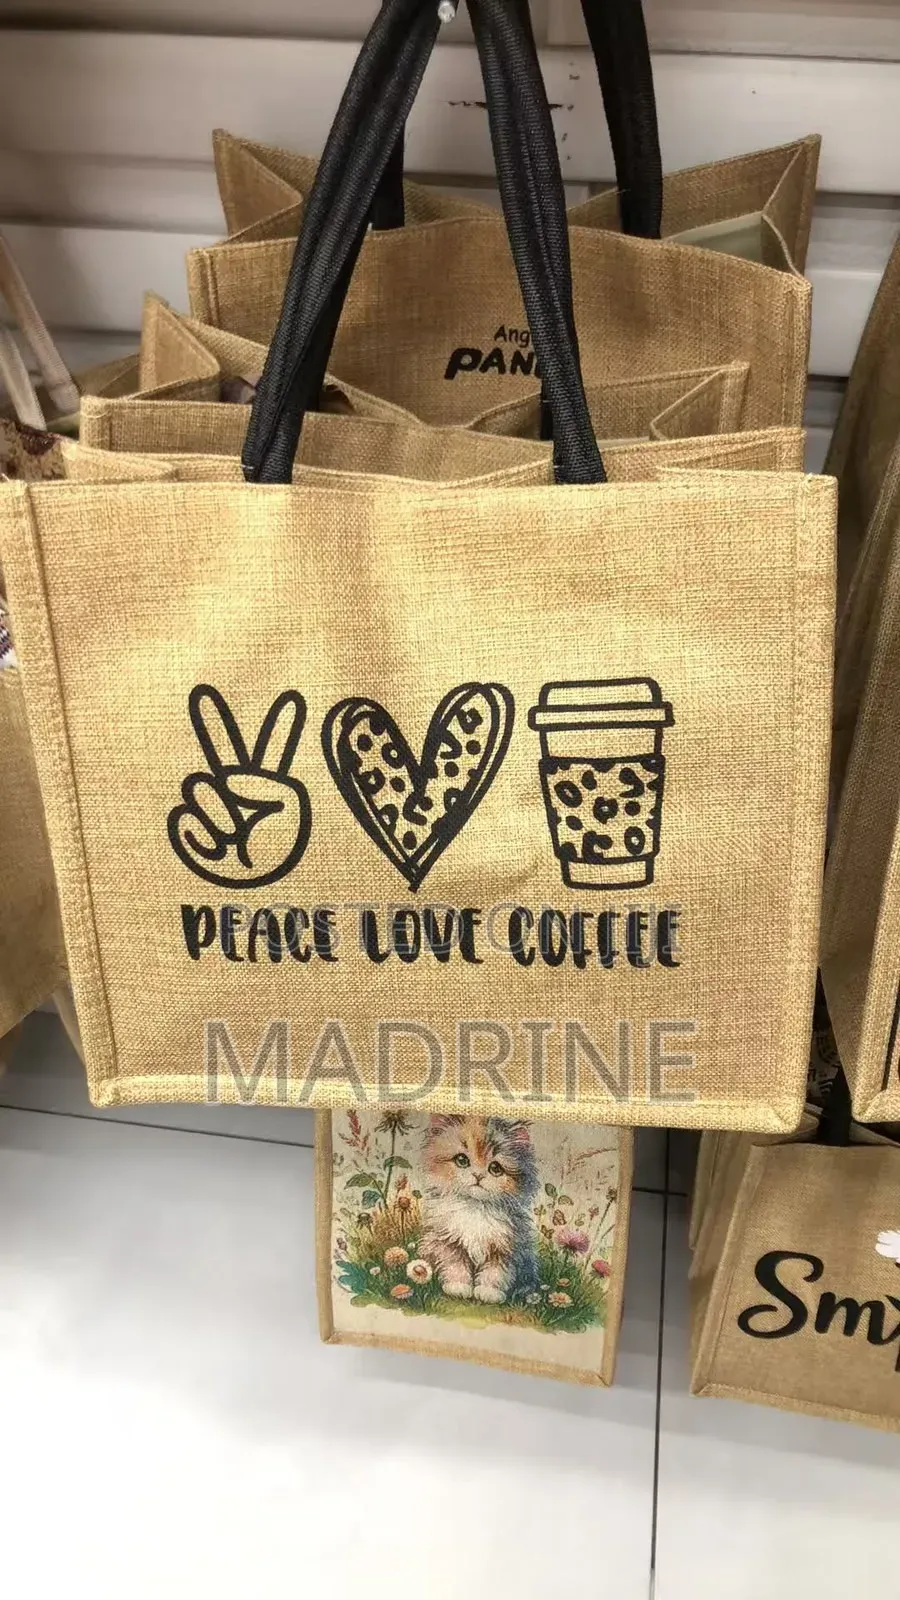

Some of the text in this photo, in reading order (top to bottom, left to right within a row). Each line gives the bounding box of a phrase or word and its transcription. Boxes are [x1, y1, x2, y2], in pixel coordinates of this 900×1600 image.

[180, 904, 682, 969] PEACE LOVE COFFEE
